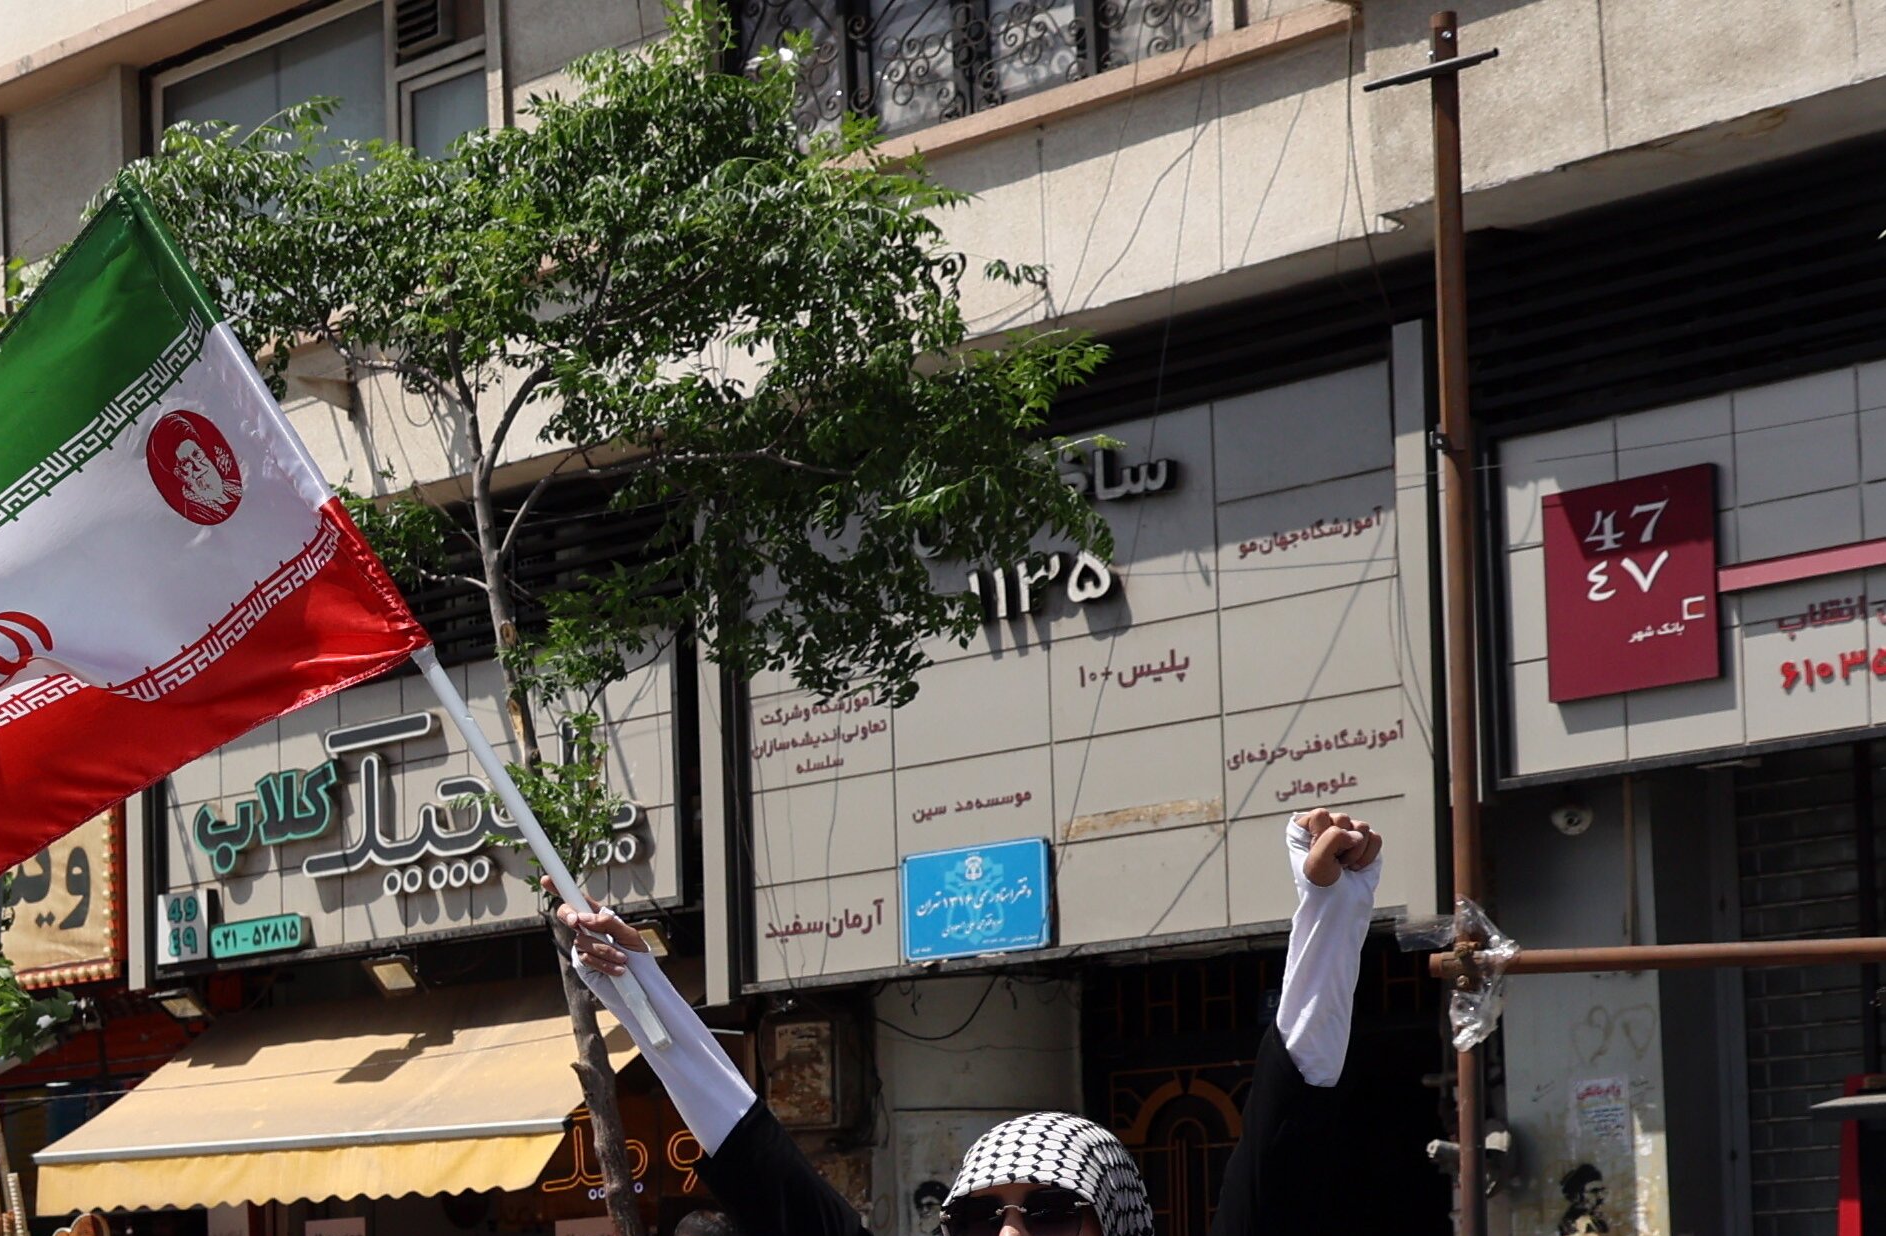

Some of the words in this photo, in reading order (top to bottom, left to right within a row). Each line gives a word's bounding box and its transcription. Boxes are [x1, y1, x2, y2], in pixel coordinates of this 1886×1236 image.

[1301, 505, 1383, 540] آموزشگاه
[1584, 498, 1669, 552] 47
[1118, 649, 1190, 688] پلیس
[760, 706, 803, 726] شرکت
[842, 718, 887, 744] تعاونی
[791, 724, 842, 750] اندیشه
[1289, 733, 1325, 762] فنی
[1325, 719, 1404, 750] آموزشگاه
[193, 760, 337, 875] کلاب
[167, 897, 198, 924] 49
[825, 899, 885, 939] آرمان
[765, 913, 826, 943] سفید
